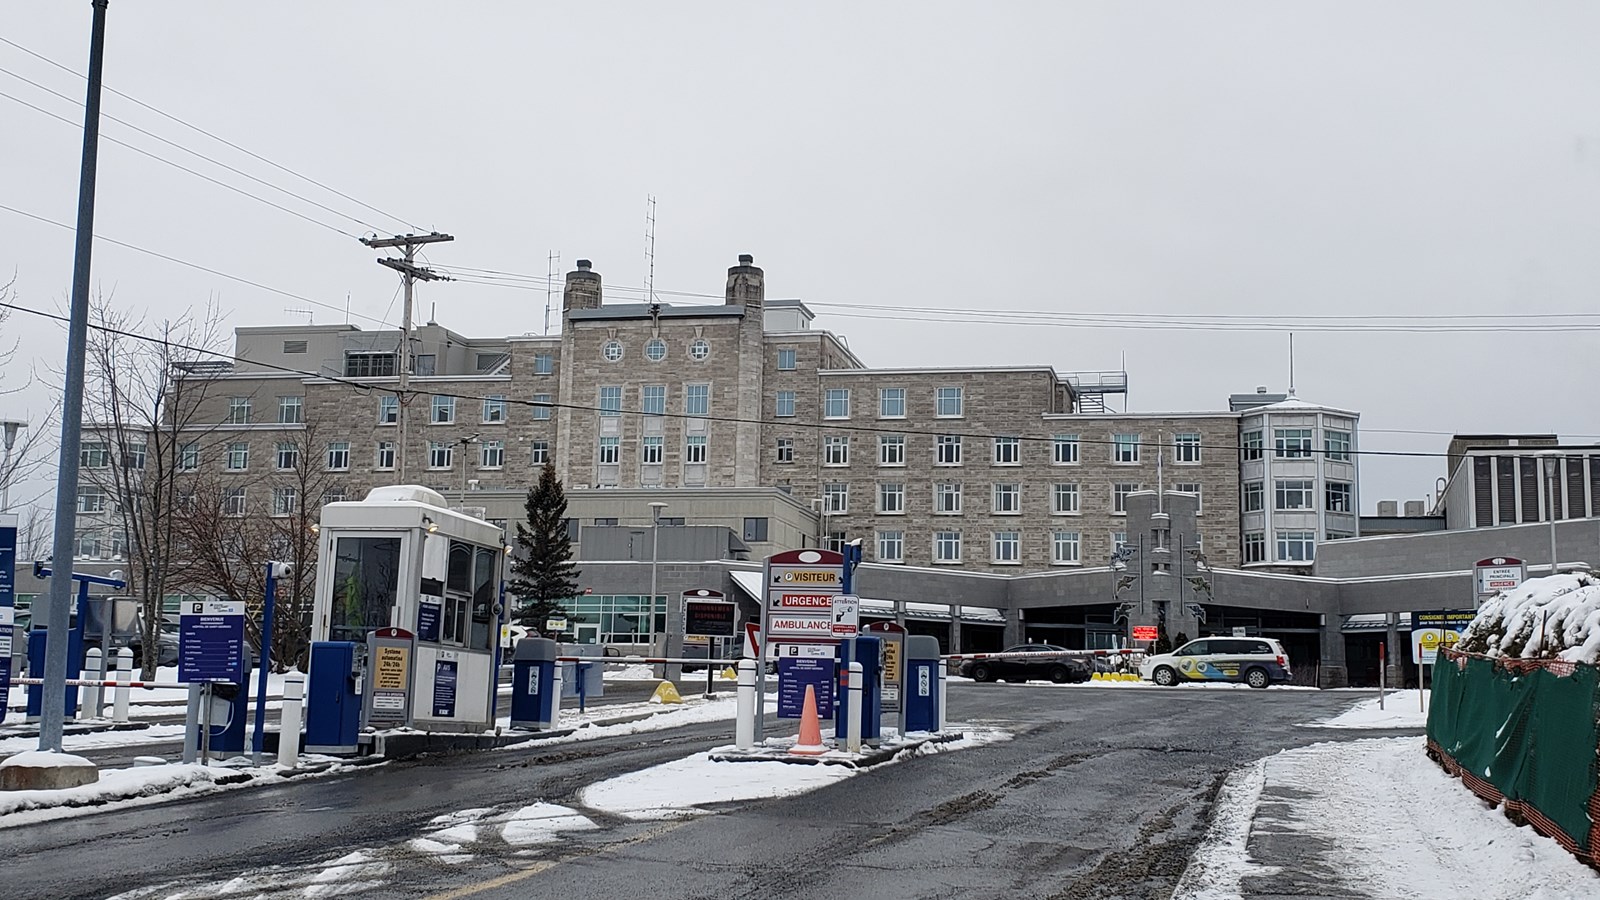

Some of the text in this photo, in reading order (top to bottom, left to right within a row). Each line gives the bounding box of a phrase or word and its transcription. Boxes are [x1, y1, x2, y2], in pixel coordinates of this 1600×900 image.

[794, 572, 836, 582] VISITEUR
[786, 596, 832, 606] URGENCE
[774, 620, 831, 629] AMBULANCE
